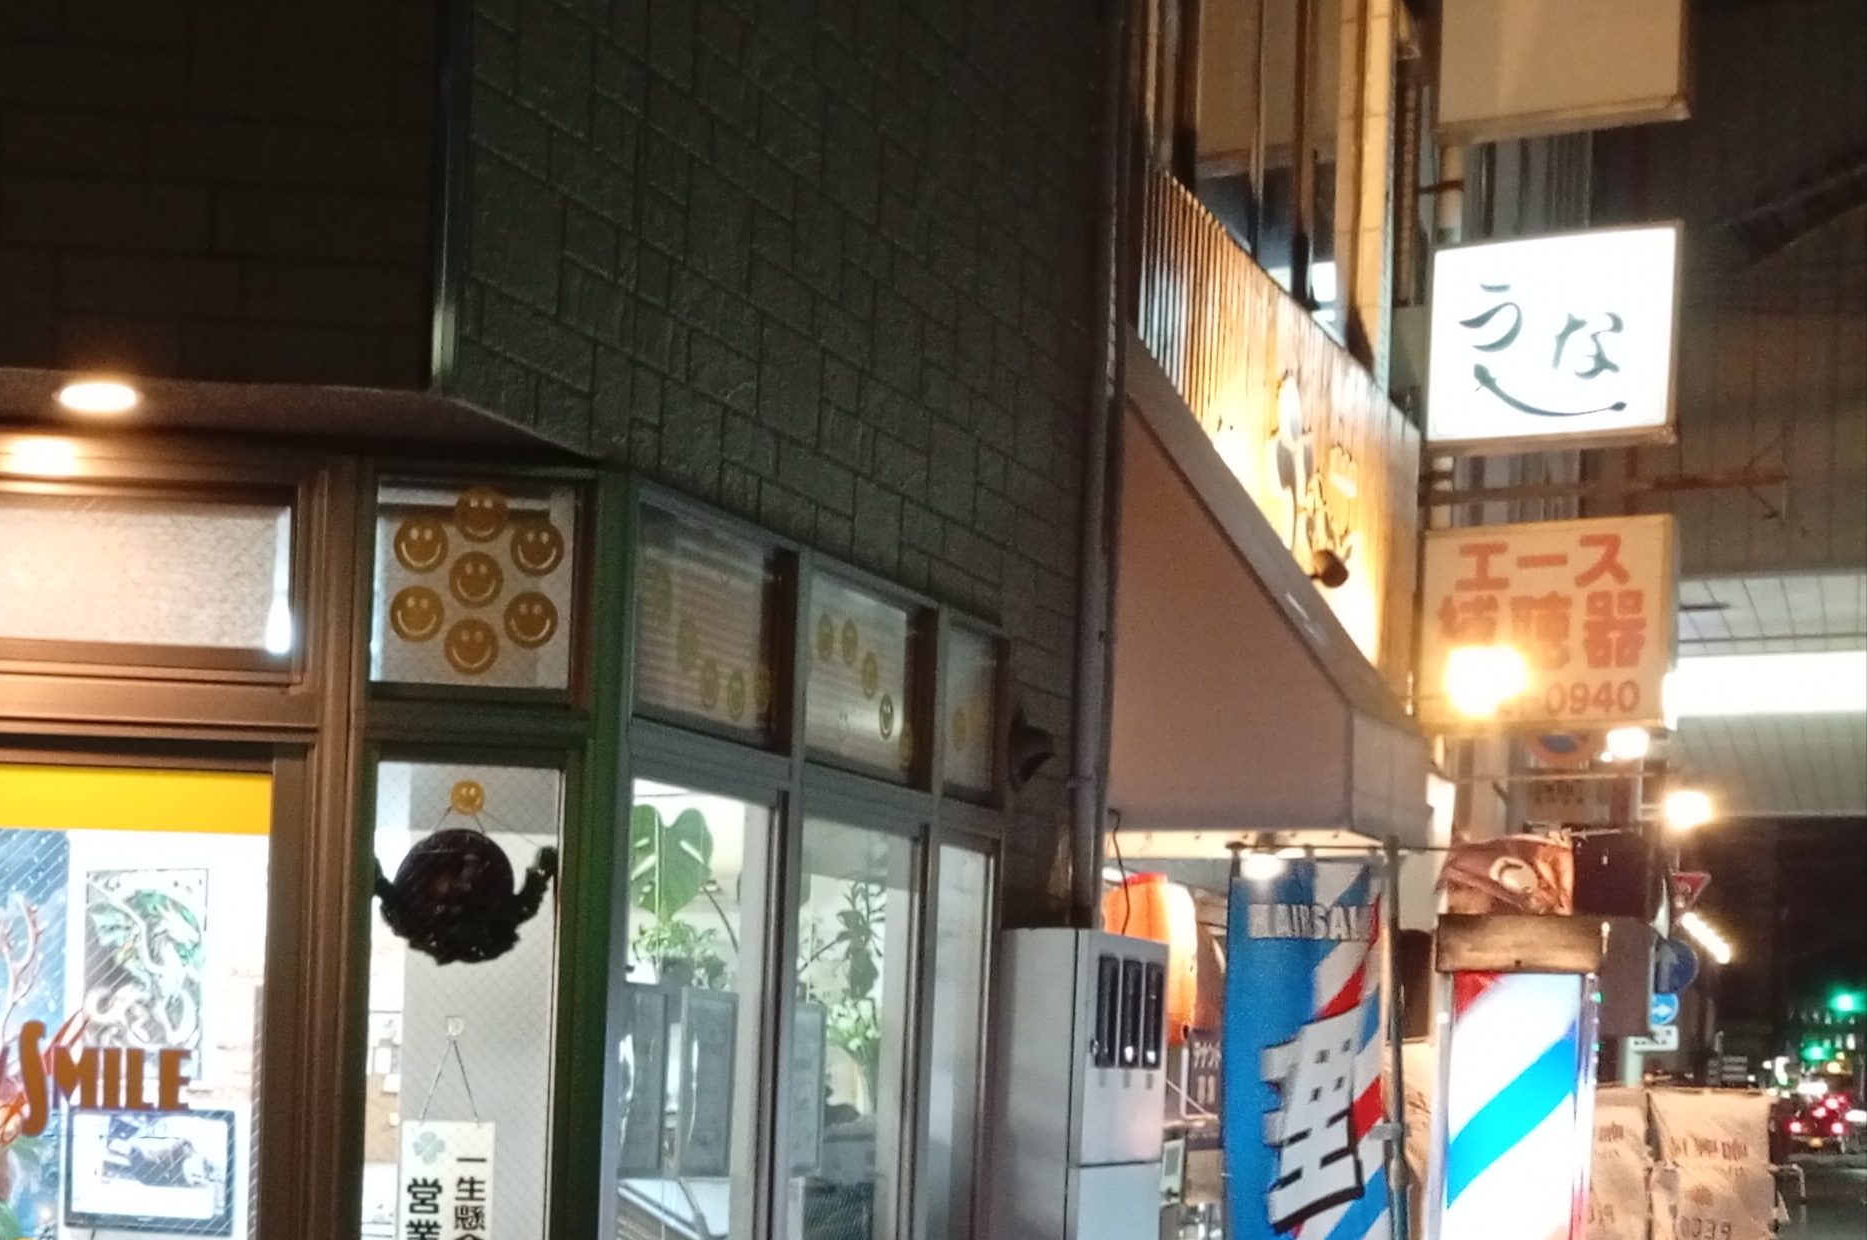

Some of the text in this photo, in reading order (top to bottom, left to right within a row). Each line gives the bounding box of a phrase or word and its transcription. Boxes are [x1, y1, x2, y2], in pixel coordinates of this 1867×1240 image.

[1454, 533, 1631, 592] エース
[19, 1020, 192, 1136] SMILE
